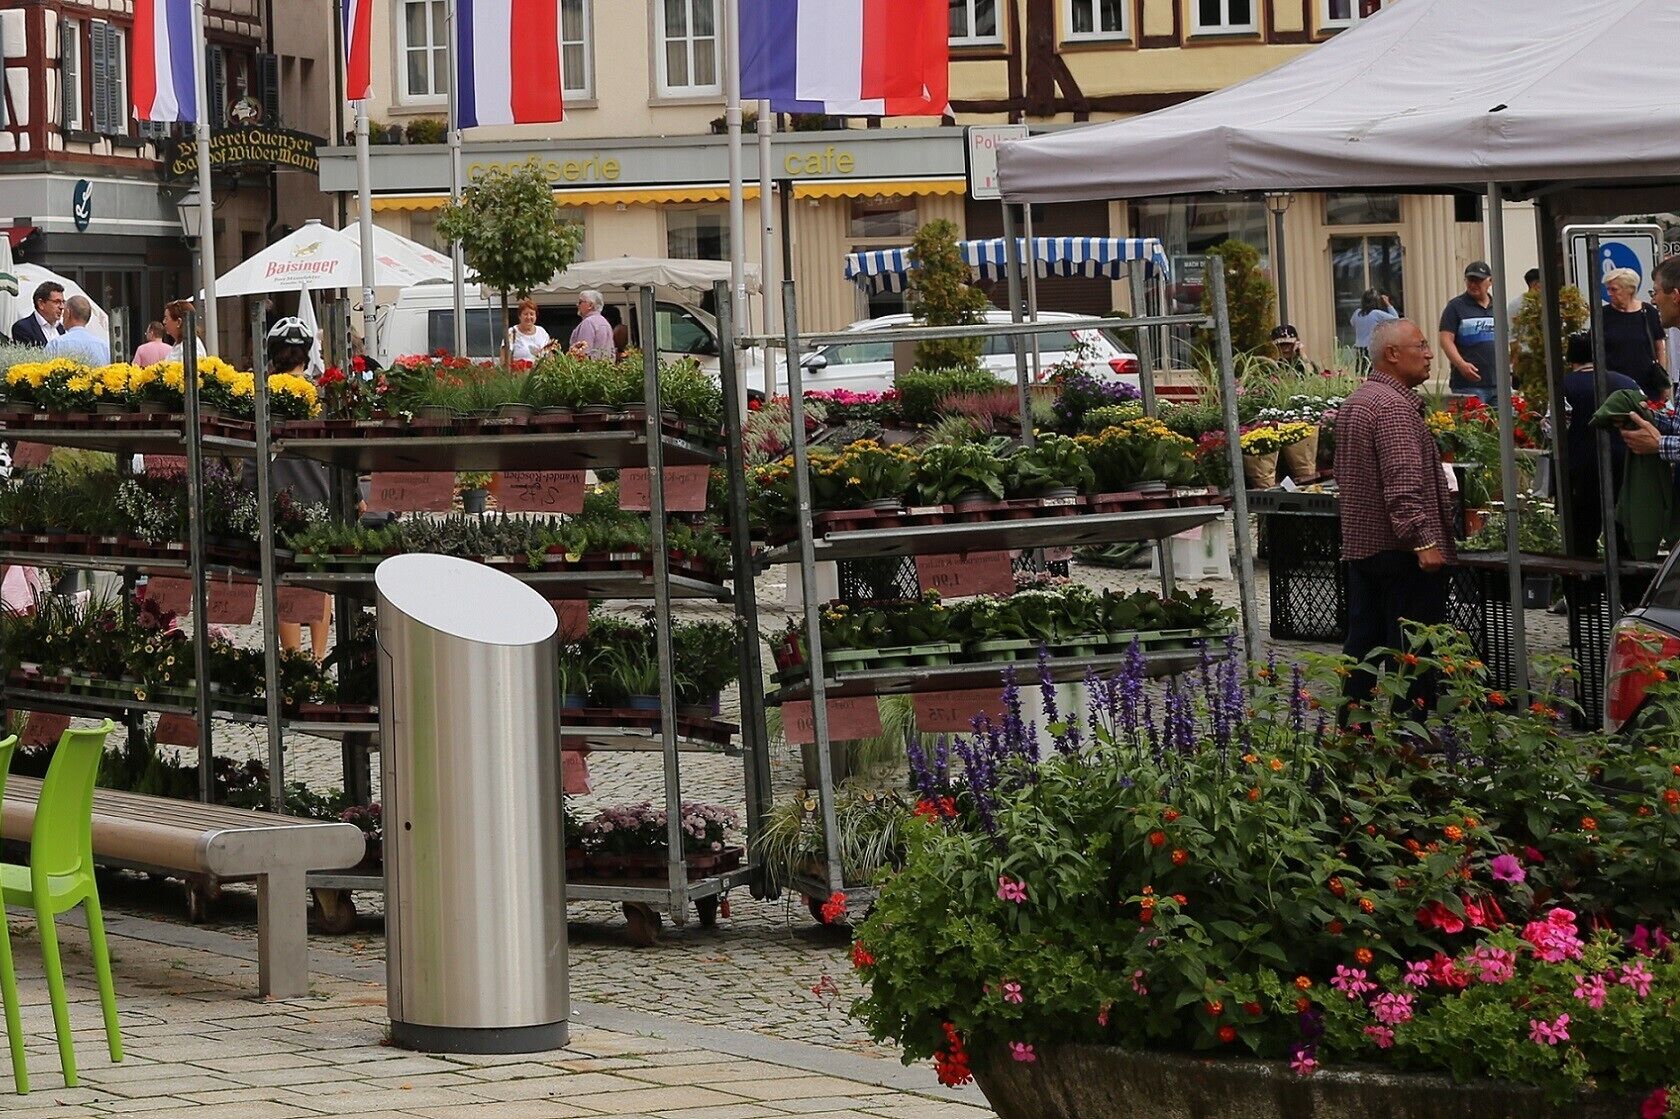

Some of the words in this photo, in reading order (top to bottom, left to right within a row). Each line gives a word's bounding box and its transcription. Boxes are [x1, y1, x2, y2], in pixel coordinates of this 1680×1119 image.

[177, 130, 246, 157] Bruerei
[249, 130, 312, 151] Quenzer
[228, 146, 278, 162] Wilder
[277, 148, 319, 171] Mann
[467, 153, 620, 181] confserie
[784, 146, 854, 174] cafe
[265, 259, 338, 278] Baisinger
